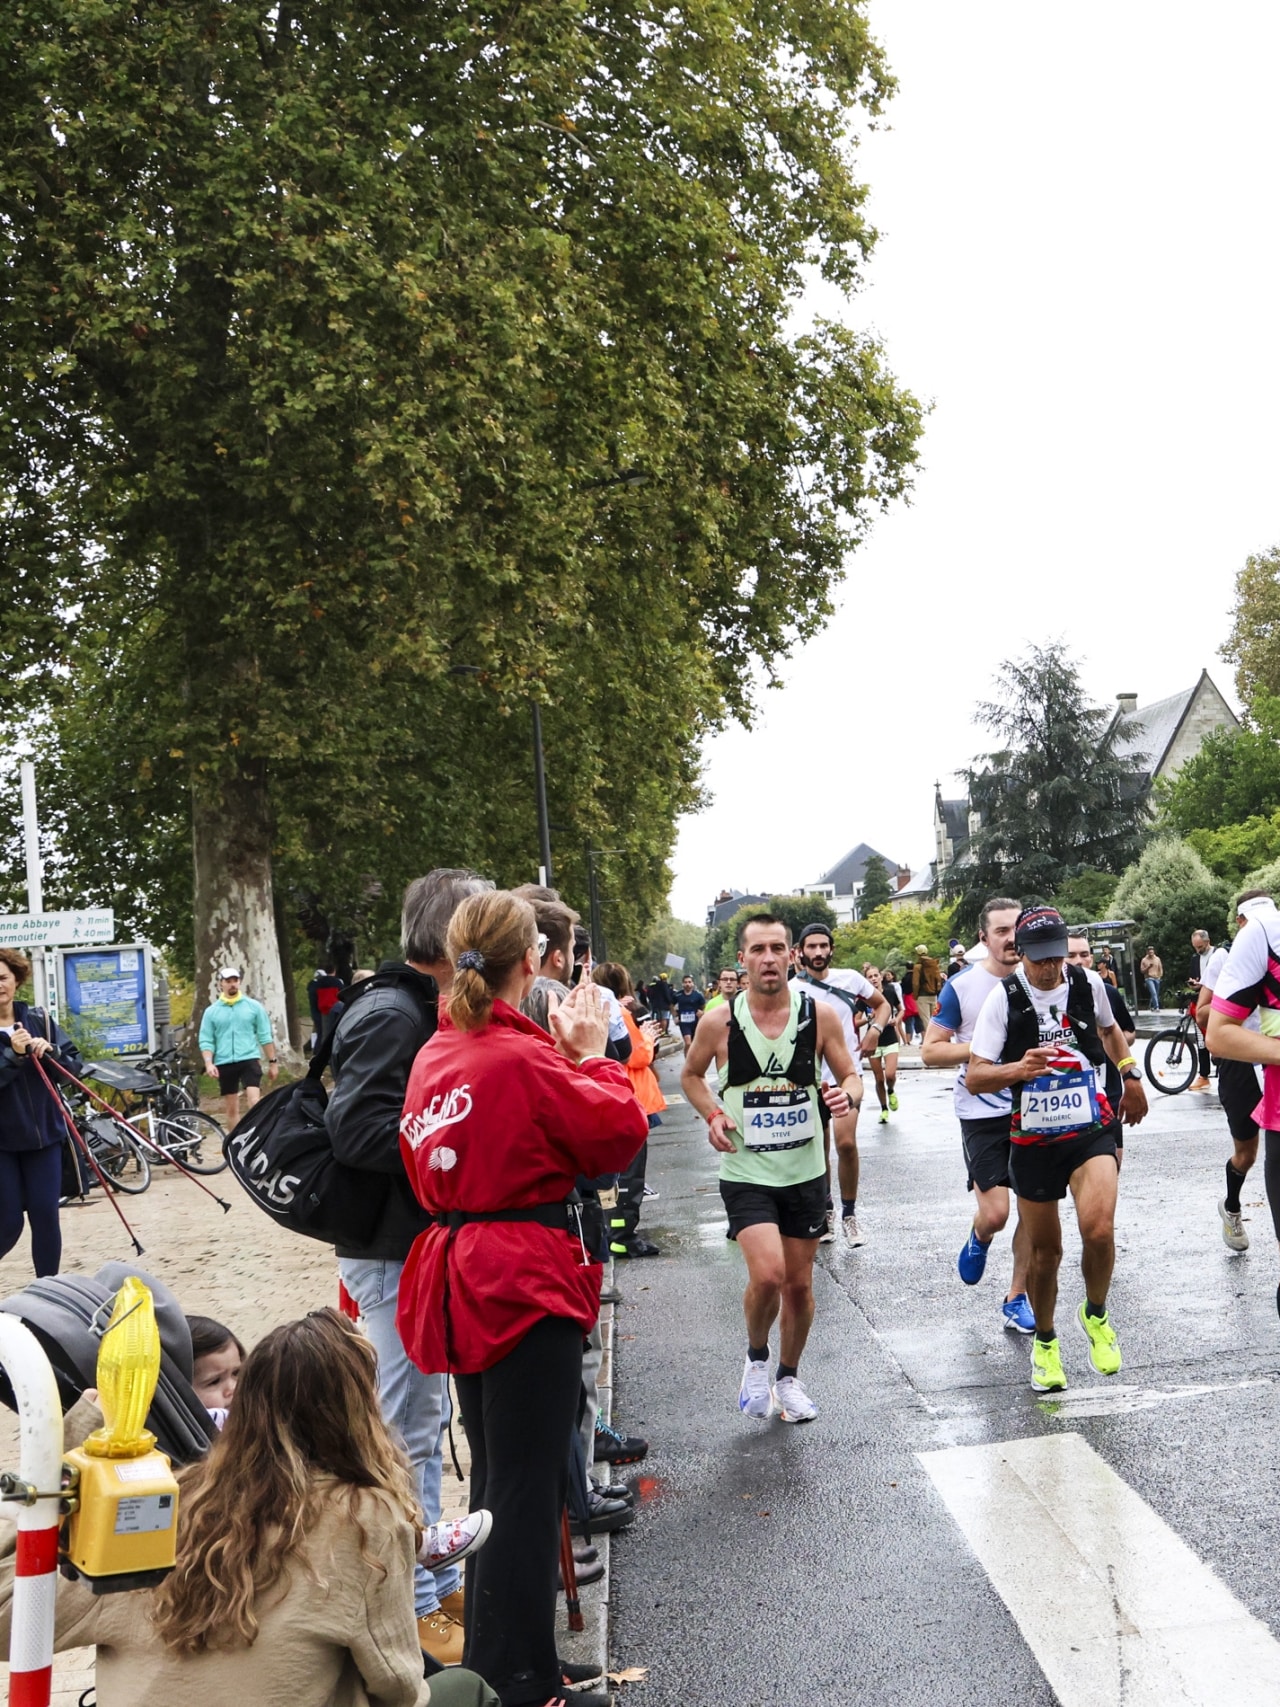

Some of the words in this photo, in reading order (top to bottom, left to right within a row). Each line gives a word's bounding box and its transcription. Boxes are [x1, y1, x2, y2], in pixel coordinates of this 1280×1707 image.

[22, 919, 60, 929] Abbaye
[95, 916, 109, 924] min
[0, 932, 48, 943] armoutier
[84, 929, 96, 937] 40
[96, 929, 111, 937] min
[1028, 1092, 1082, 1113] 21940
[751, 1108, 808, 1129] 43450
[1041, 1113, 1072, 1122] FRÉDÉRIC
[771, 1130, 791, 1138] STEVE
